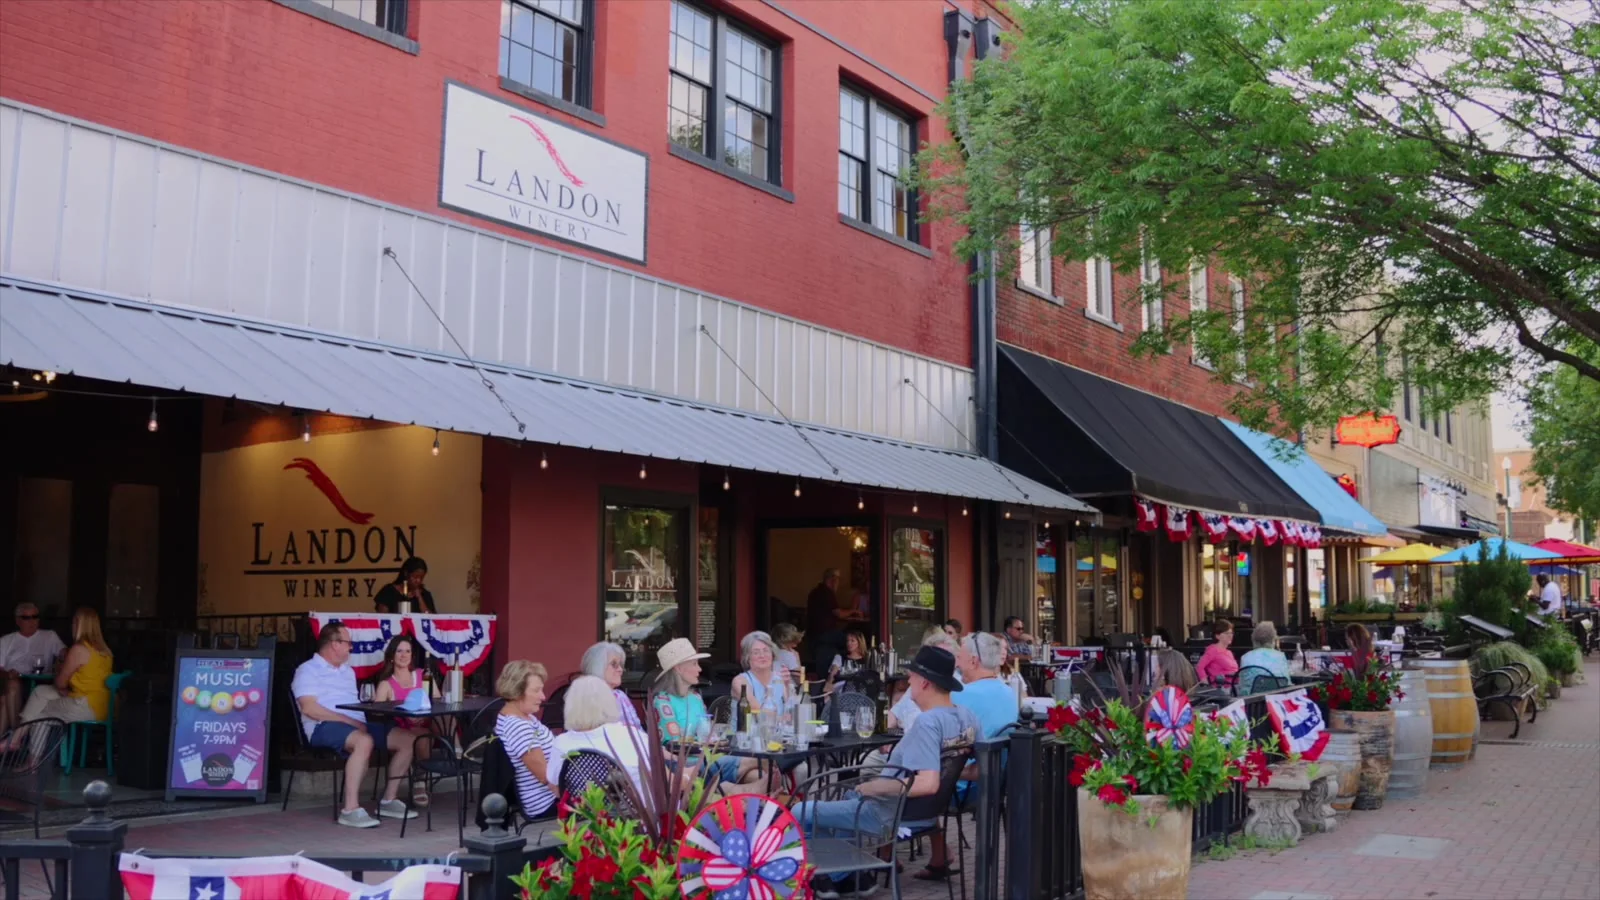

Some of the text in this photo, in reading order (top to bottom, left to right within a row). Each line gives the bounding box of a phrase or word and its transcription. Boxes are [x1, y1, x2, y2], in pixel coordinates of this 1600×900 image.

[475, 147, 622, 226] LANDON
[508, 204, 592, 242] WINERY
[250, 522, 417, 565] LANDON
[611, 570, 675, 589] LANDON
[895, 579, 934, 592] LAND
[283, 577, 377, 599] WINERY
[196, 672, 252, 686] MUSIC
[193, 721, 247, 733] FRIDAYS
[203, 735, 237, 745] 7-9PM
[202, 766, 234, 774] LANDON
